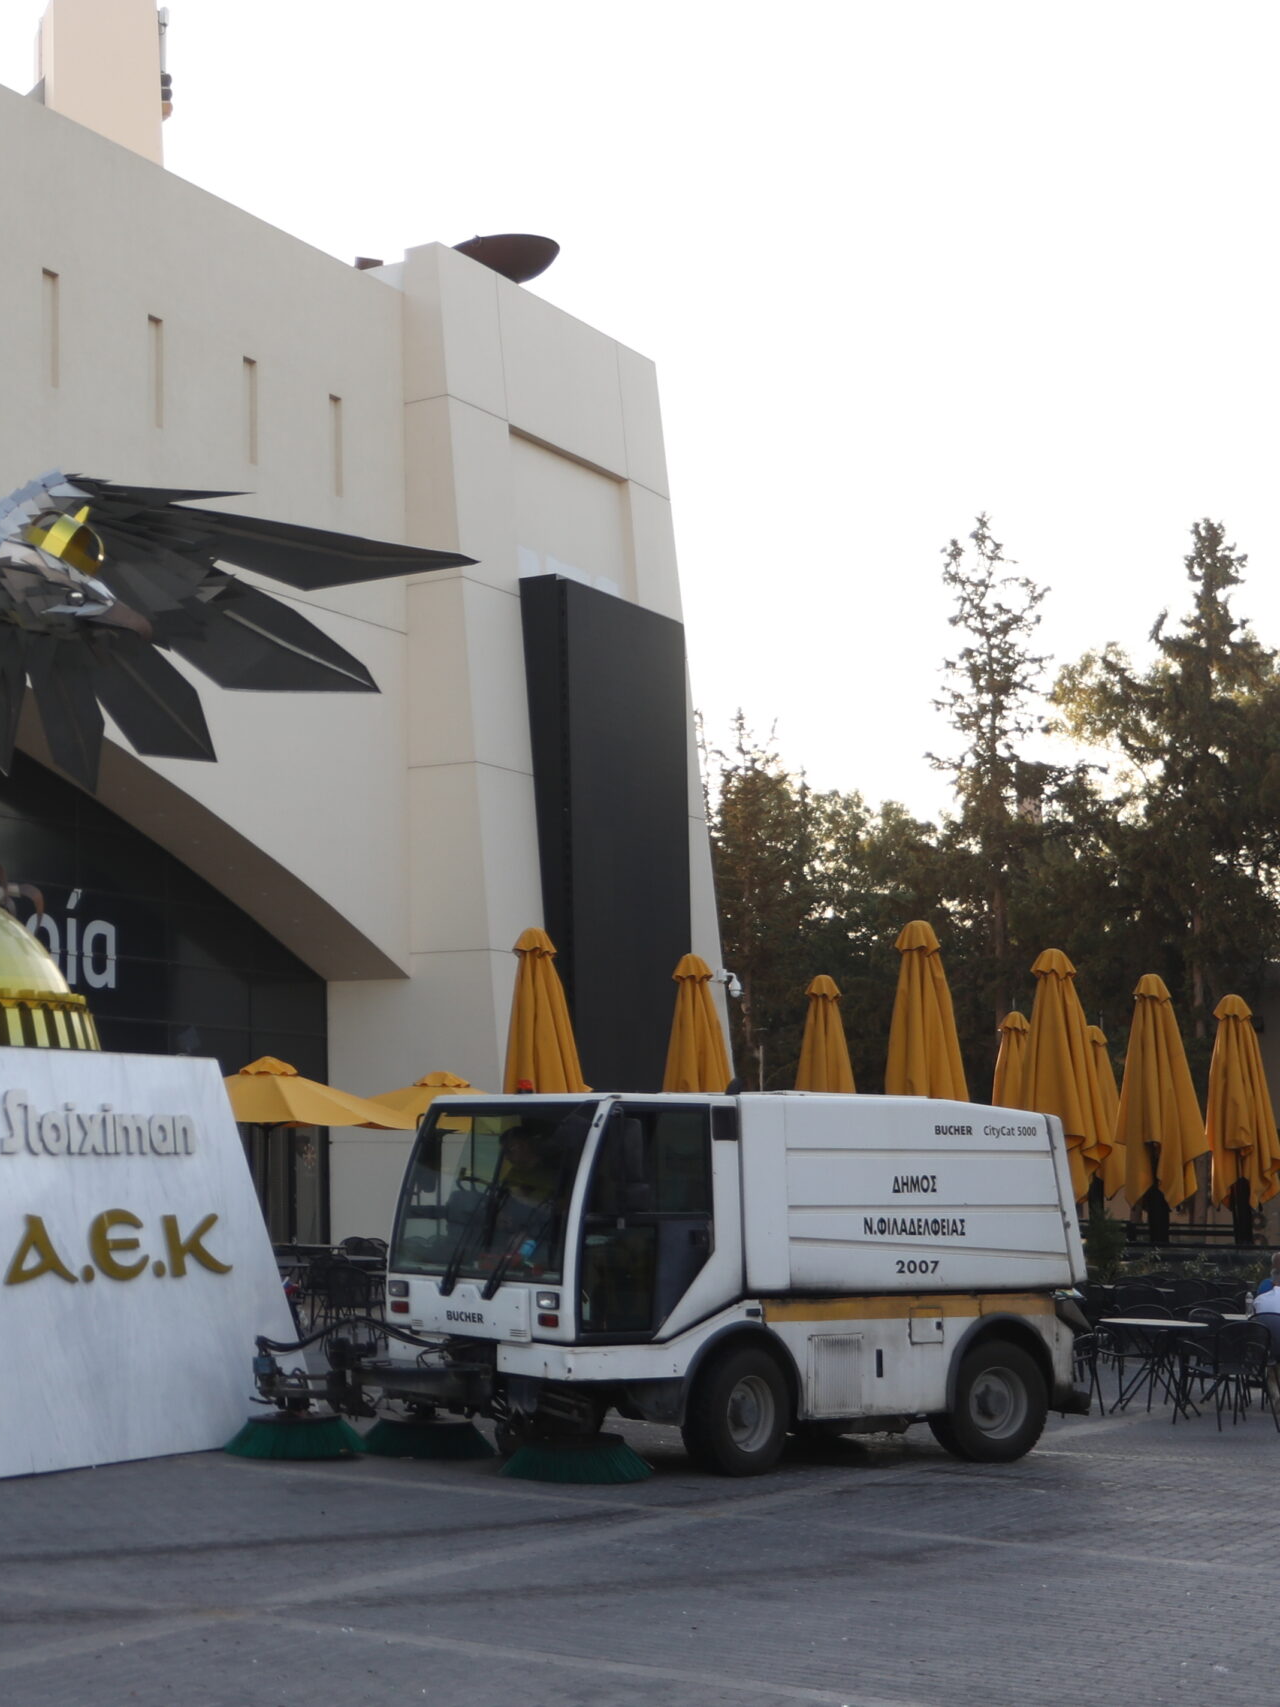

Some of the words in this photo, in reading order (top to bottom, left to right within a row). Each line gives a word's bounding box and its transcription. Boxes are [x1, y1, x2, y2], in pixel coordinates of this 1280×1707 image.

[0, 1088, 197, 1156] Stoiximan
[934, 1125, 973, 1136] BUCHER
[983, 1125, 1015, 1139] CityCat
[1017, 1126, 1037, 1137] 5000
[892, 1175, 937, 1194] ΔΗΜΟΣ
[895, 1260, 940, 1274] 2007
[446, 1310, 484, 1324] BUCHER
